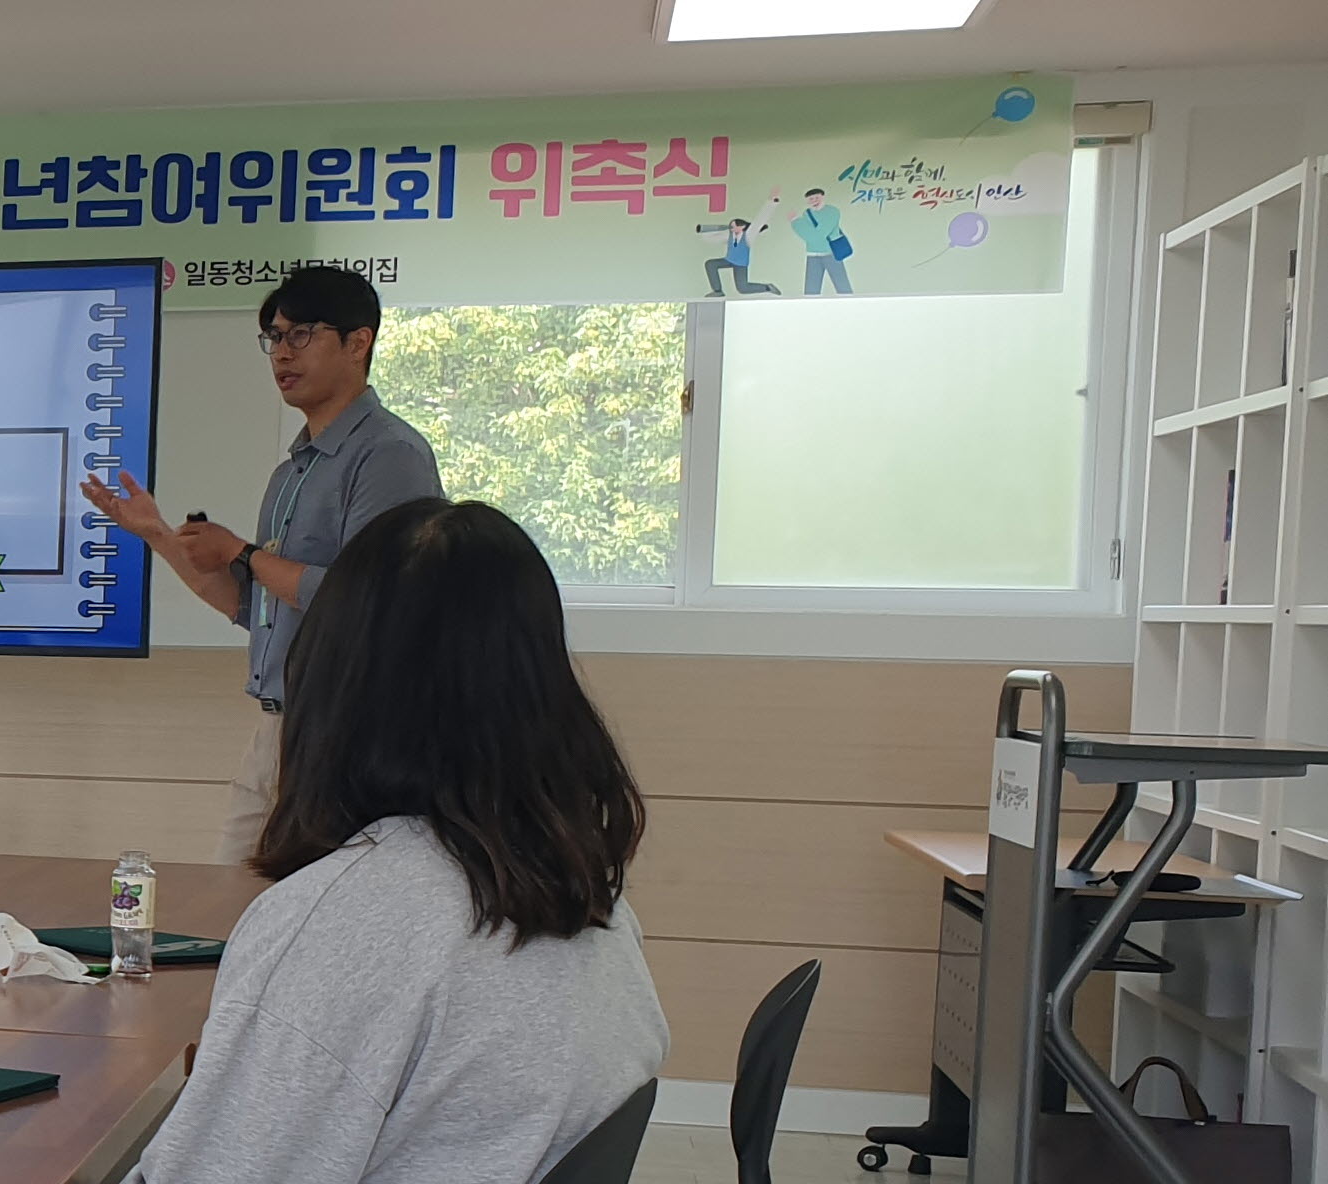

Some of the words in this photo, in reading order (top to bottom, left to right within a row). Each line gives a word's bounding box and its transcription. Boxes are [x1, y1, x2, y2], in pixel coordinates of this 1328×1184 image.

[488, 135, 732, 218] 위촉식
[838, 159, 900, 192] 시민과
[850, 187, 907, 214] 자유로운
[912, 183, 983, 210] 혁신도시
[985, 184, 1028, 201] 안산
